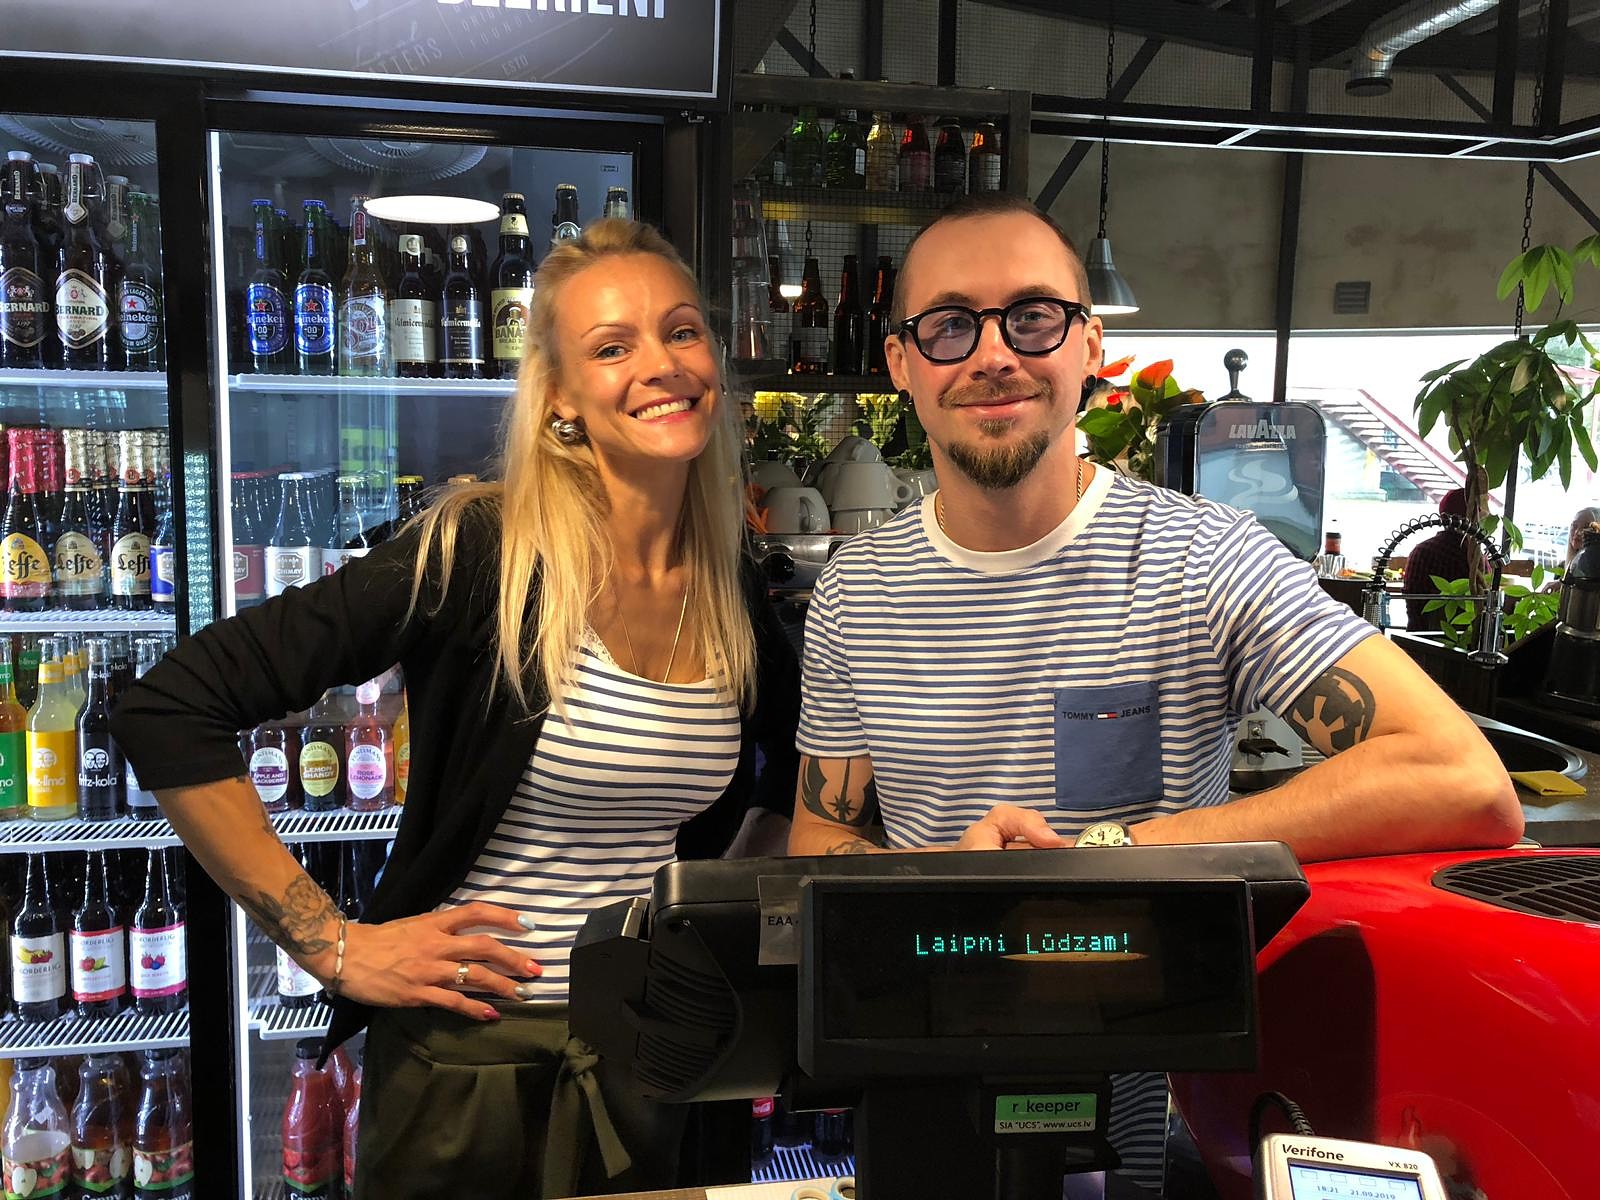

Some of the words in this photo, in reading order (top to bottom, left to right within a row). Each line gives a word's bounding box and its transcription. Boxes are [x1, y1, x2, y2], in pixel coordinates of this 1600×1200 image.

[55, 304, 104, 316] BERNARD
[120, 312, 158, 323] eineken
[1229, 419, 1297, 439] LAVAZZA
[57, 552, 94, 575] Leffe
[1062, 711, 1095, 721] TOMMY
[1120, 705, 1151, 718] JEANS
[79, 773, 117, 787] fritz-kola
[915, 933, 1006, 956] Laipni
[1026, 932, 1130, 954] Lūdzam!
[1000, 1121, 1013, 1130] SIA
[1282, 1143, 1345, 1161] Verifone
[1388, 1160, 1402, 1168] VX
[1403, 1163, 1419, 1171] 820
